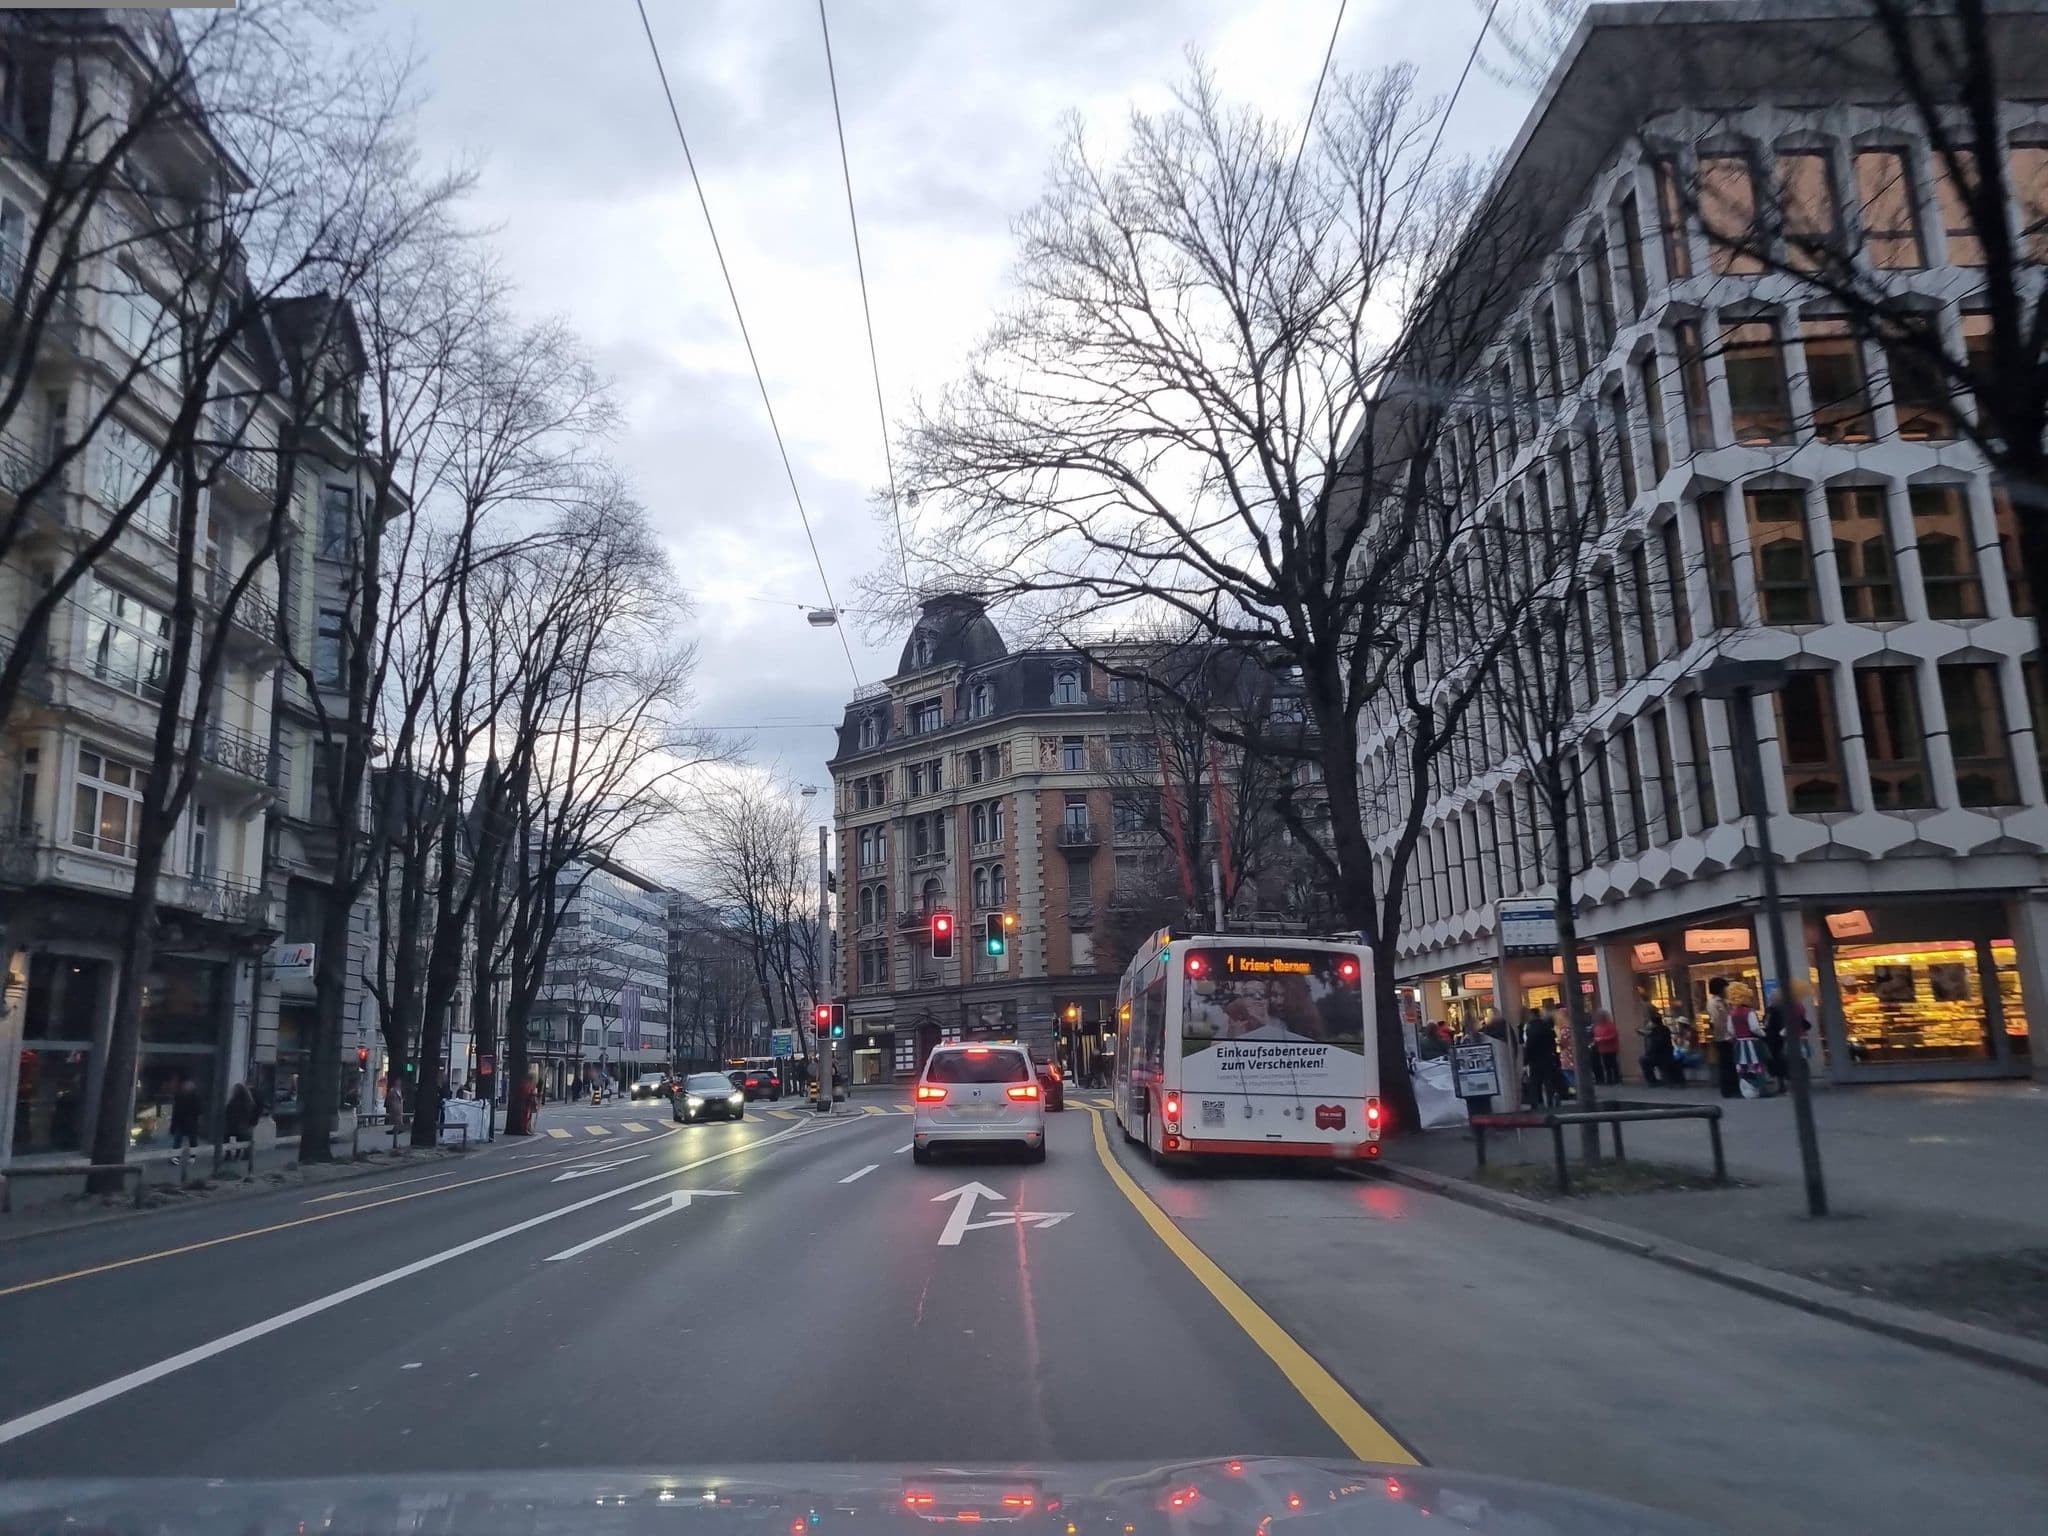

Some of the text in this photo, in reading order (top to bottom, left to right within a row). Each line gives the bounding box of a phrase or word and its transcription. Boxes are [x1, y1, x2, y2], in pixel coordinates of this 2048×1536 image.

[1227, 954, 1234, 973] 1
[1216, 1046, 1329, 1059] Einkaufsabenteuer
[1221, 1058, 1325, 1071] zum Verschenken!
